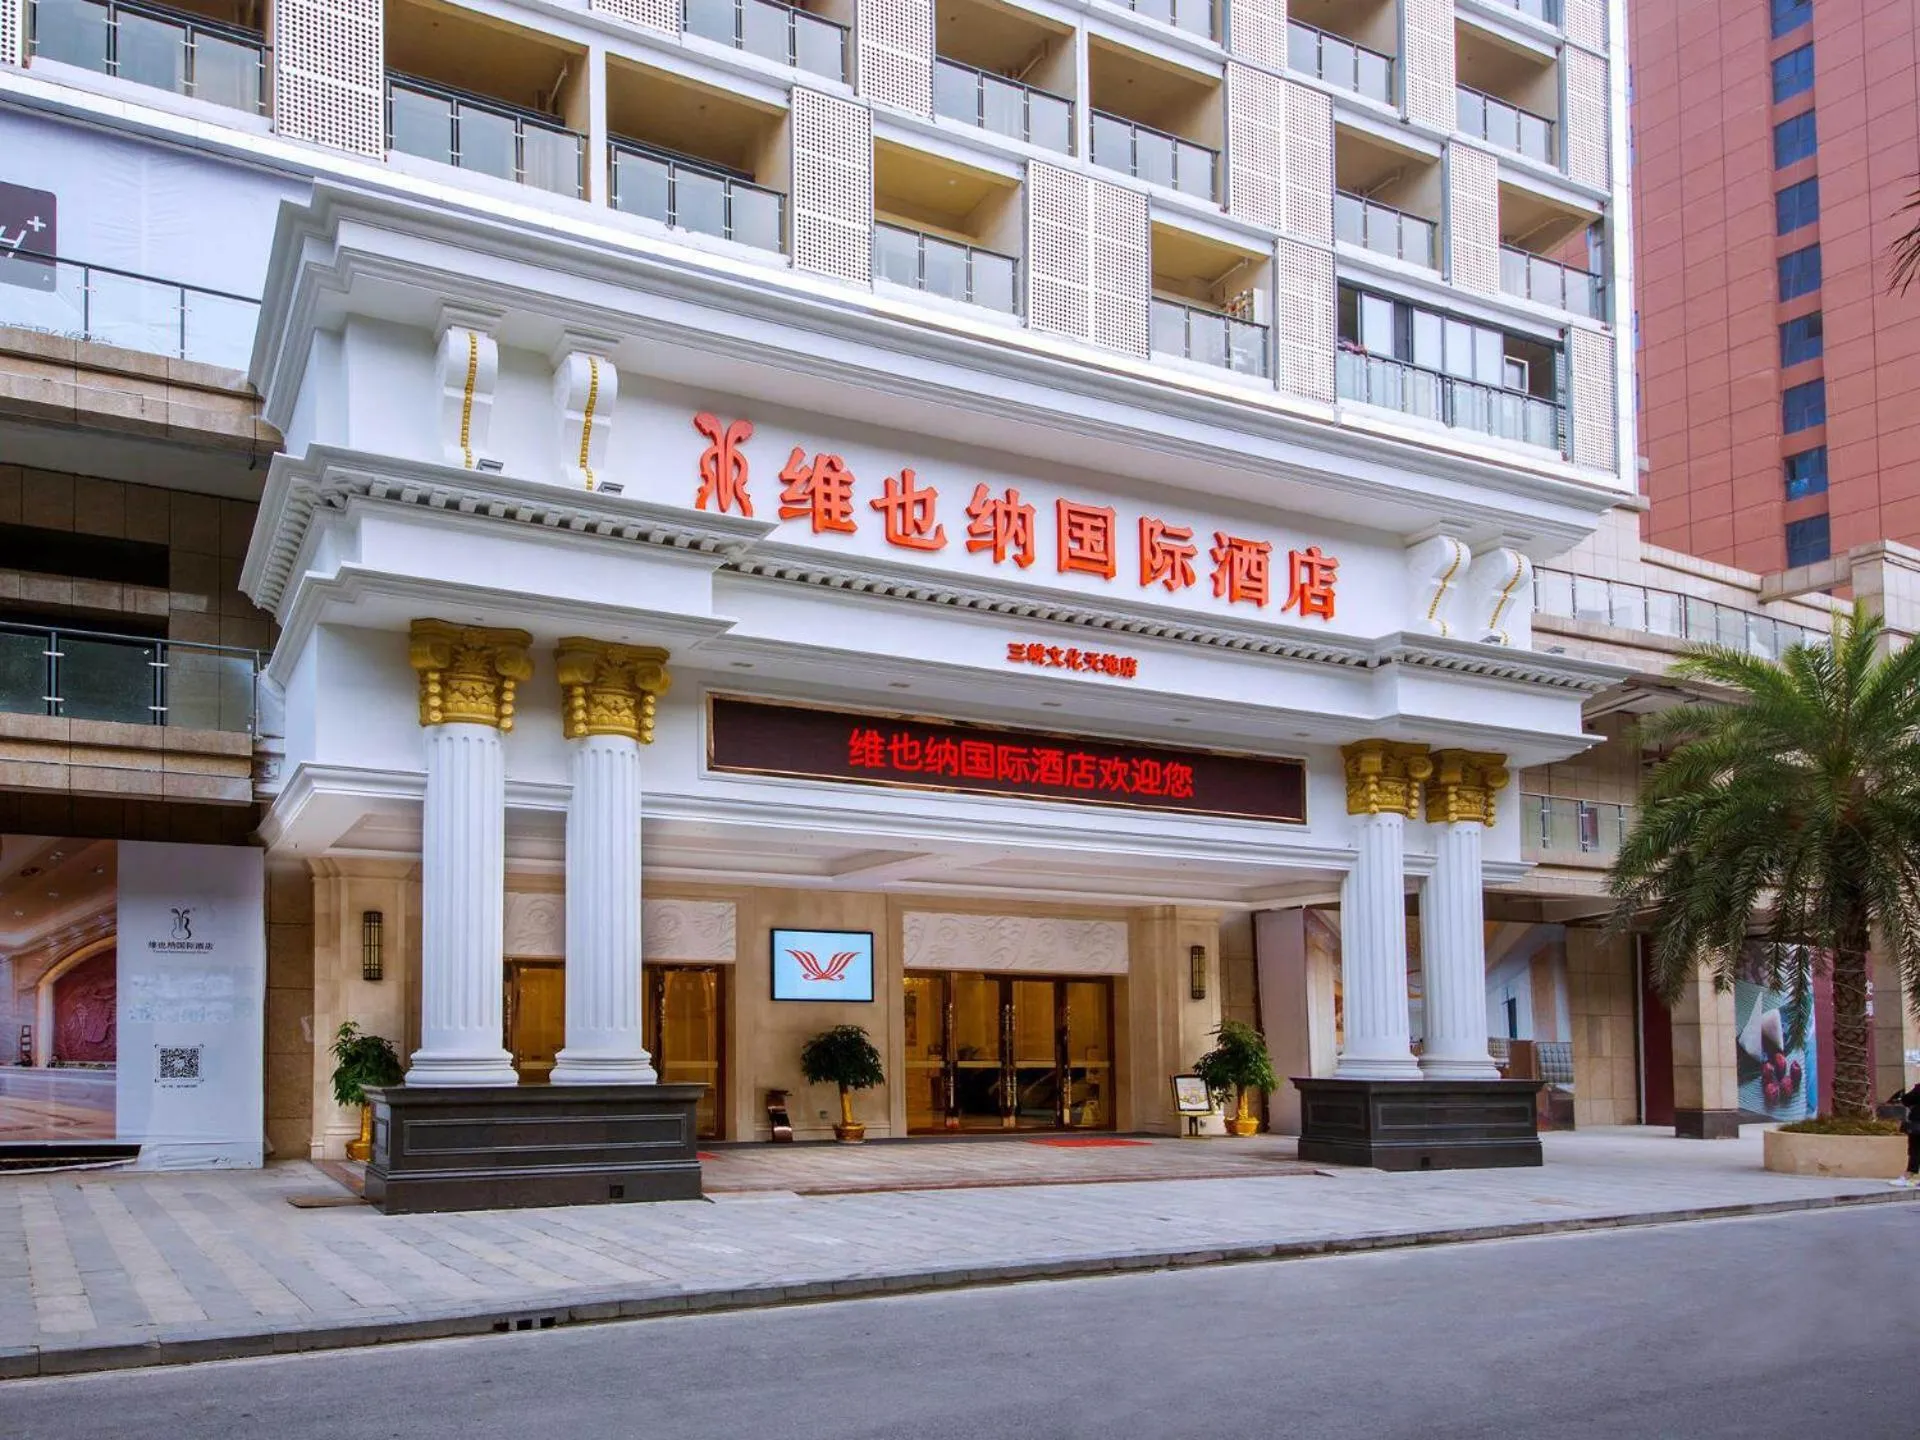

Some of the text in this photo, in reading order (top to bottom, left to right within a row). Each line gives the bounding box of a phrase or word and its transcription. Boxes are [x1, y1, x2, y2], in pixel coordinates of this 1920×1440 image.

[778, 445, 1338, 621] 维也纳国际酒店
[848, 728, 1194, 799] 维也纳国际酒店欢迎您
